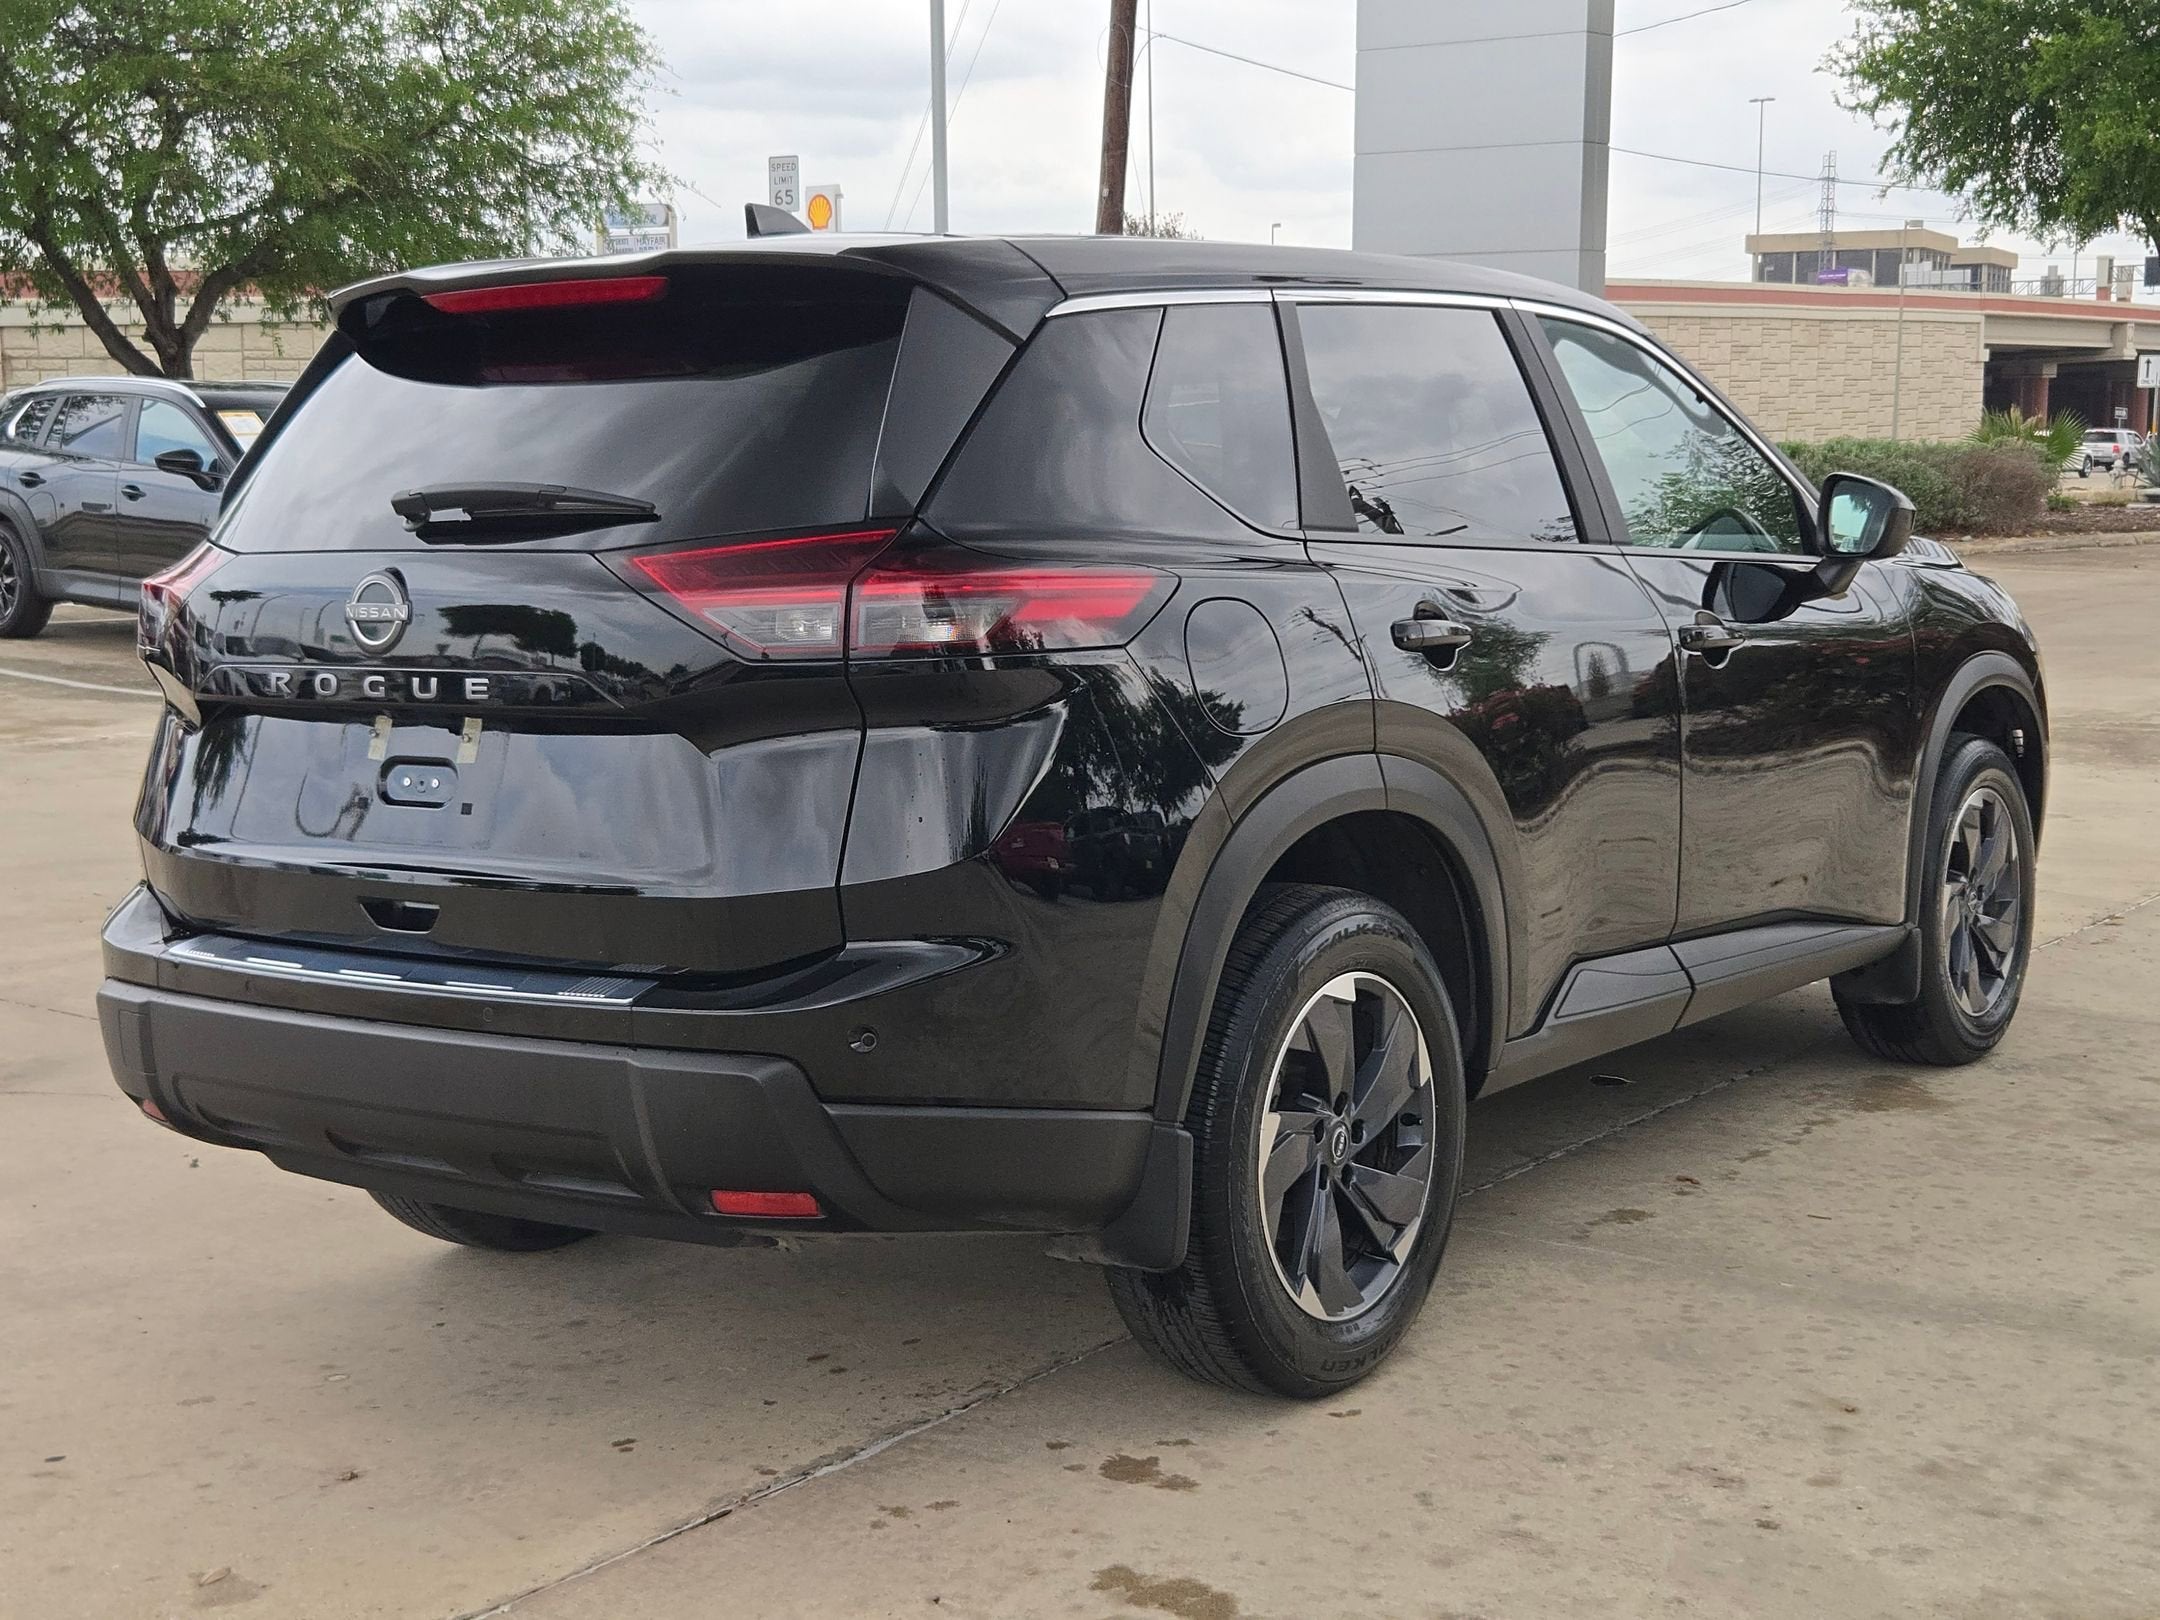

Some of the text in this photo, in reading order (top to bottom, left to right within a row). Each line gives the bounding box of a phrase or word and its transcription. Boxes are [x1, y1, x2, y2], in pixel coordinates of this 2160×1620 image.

[771, 162, 797, 172] SPEED
[773, 175, 793, 185] LIMIT
[774, 189, 794, 206] 65
[346, 606, 406, 618] NISSAN
[269, 672, 489, 700] ROGUE
